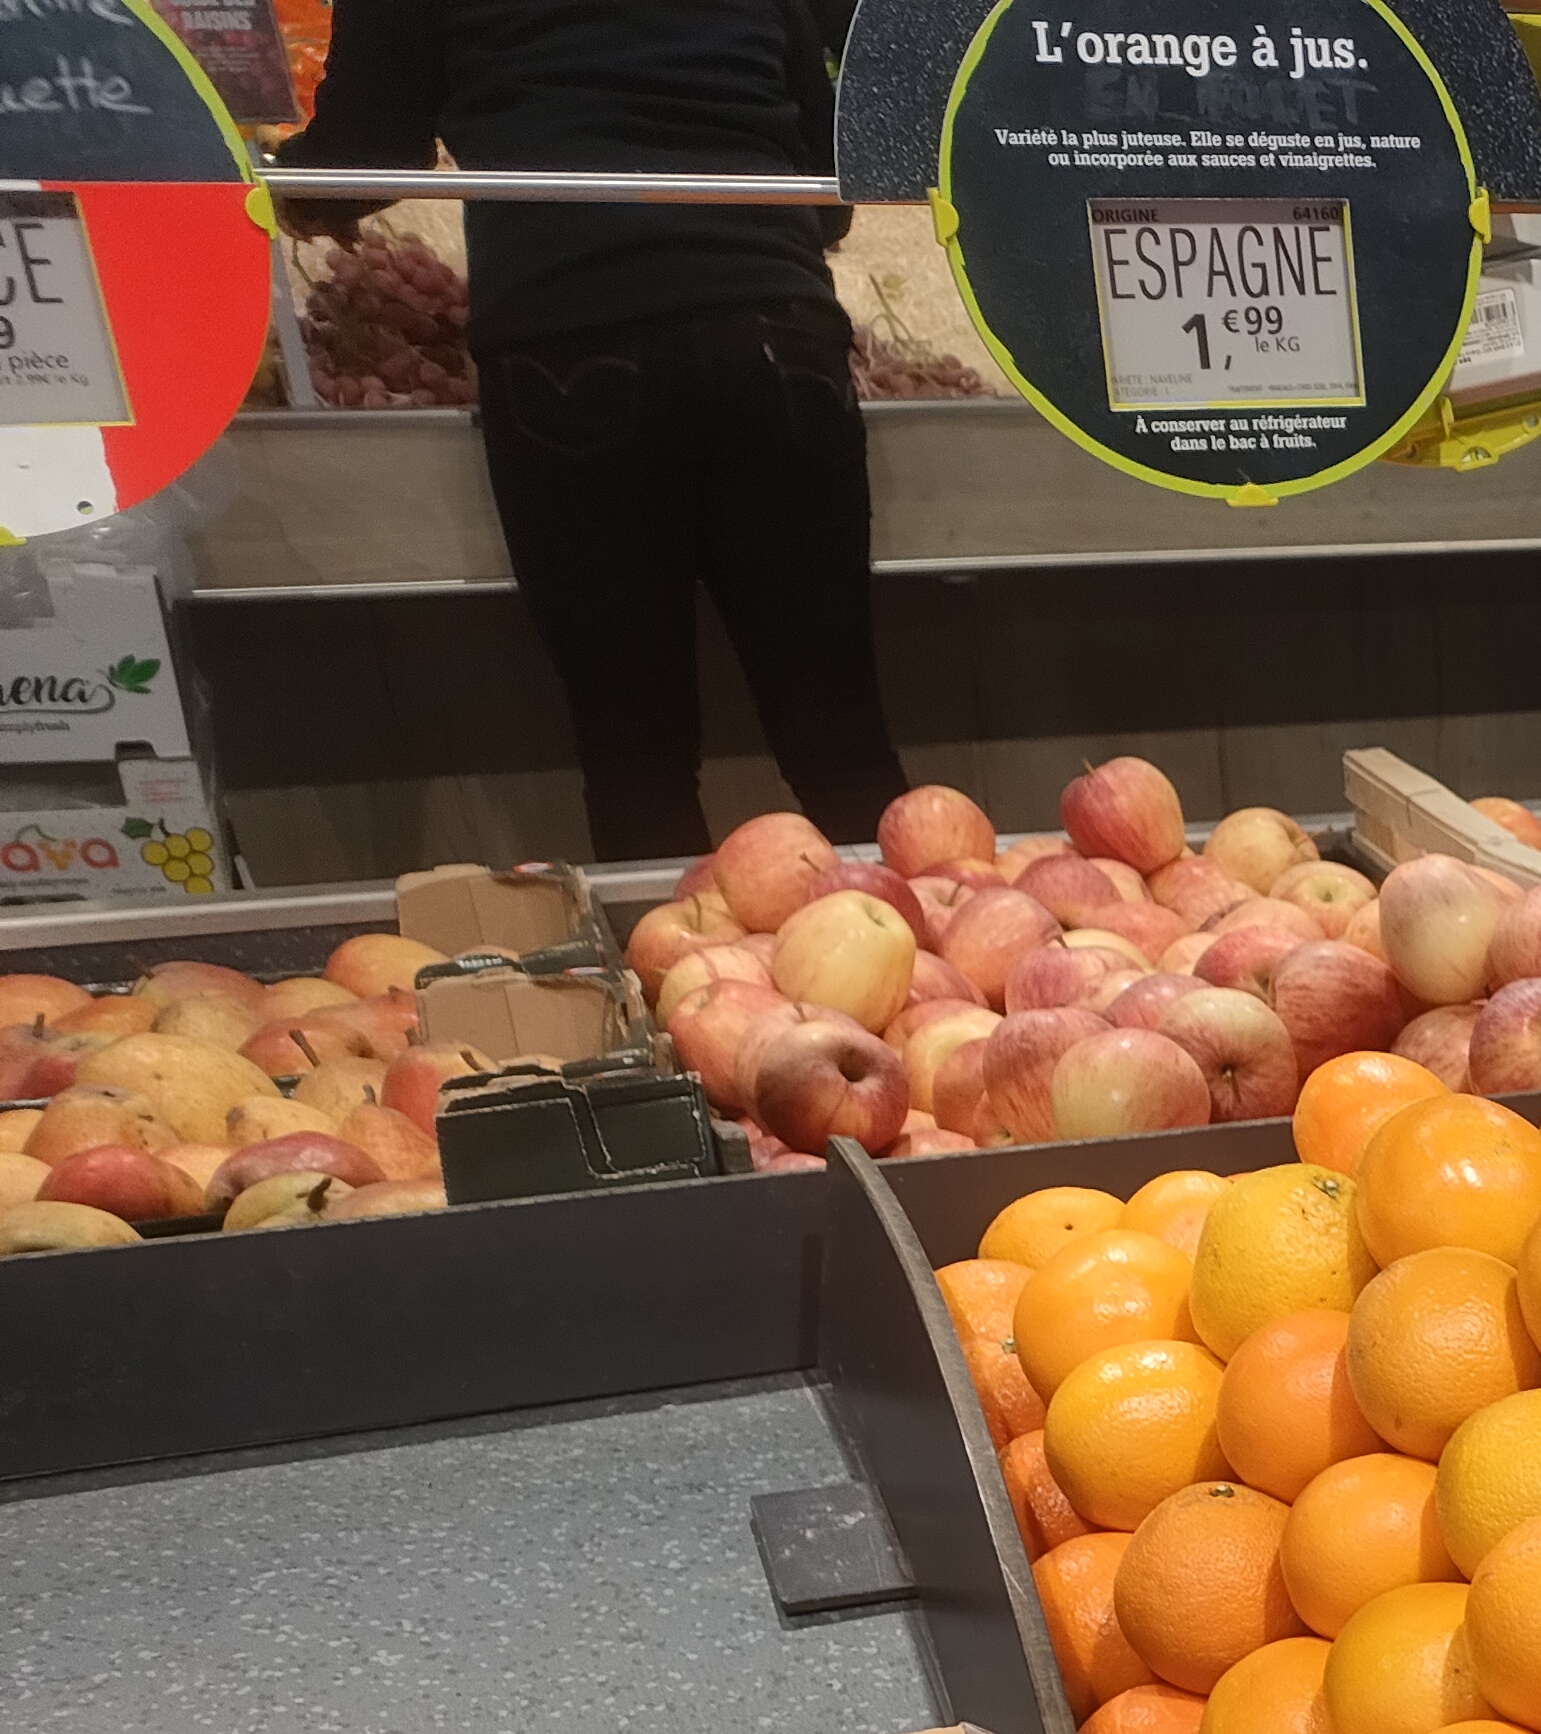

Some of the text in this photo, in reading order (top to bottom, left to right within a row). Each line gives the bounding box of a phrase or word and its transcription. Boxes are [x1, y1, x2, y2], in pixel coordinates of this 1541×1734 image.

[1032, 21, 1369, 78] L'orange à jus.
[1061, 130, 1079, 146] la
[1082, 130, 1118, 150] plus
[1121, 131, 1187, 150] juteuse.
[1190, 131, 1222, 147] Elle
[1226, 135, 1244, 148] se
[1248, 131, 1311, 151] déguste
[1314, 136, 1335, 148] en
[1337, 133, 1367, 151] jus,
[1370, 135, 1421, 149] nature
[1048, 150, 1377, 171] ou incorporée aux sauces et vinaigrettes.
[1103, 225, 1338, 300] ESPAGNE
[1255, 337, 1300, 352] le KG
[8, 351, 70, 374] pièce
[1151, 419, 1225, 432] conserver
[1229, 419, 1248, 431] au
[1171, 436, 1208, 451] dans
[1211, 435, 1226, 450] le
[1229, 435, 1256, 449] bac
[1260, 433, 1269, 448] à
